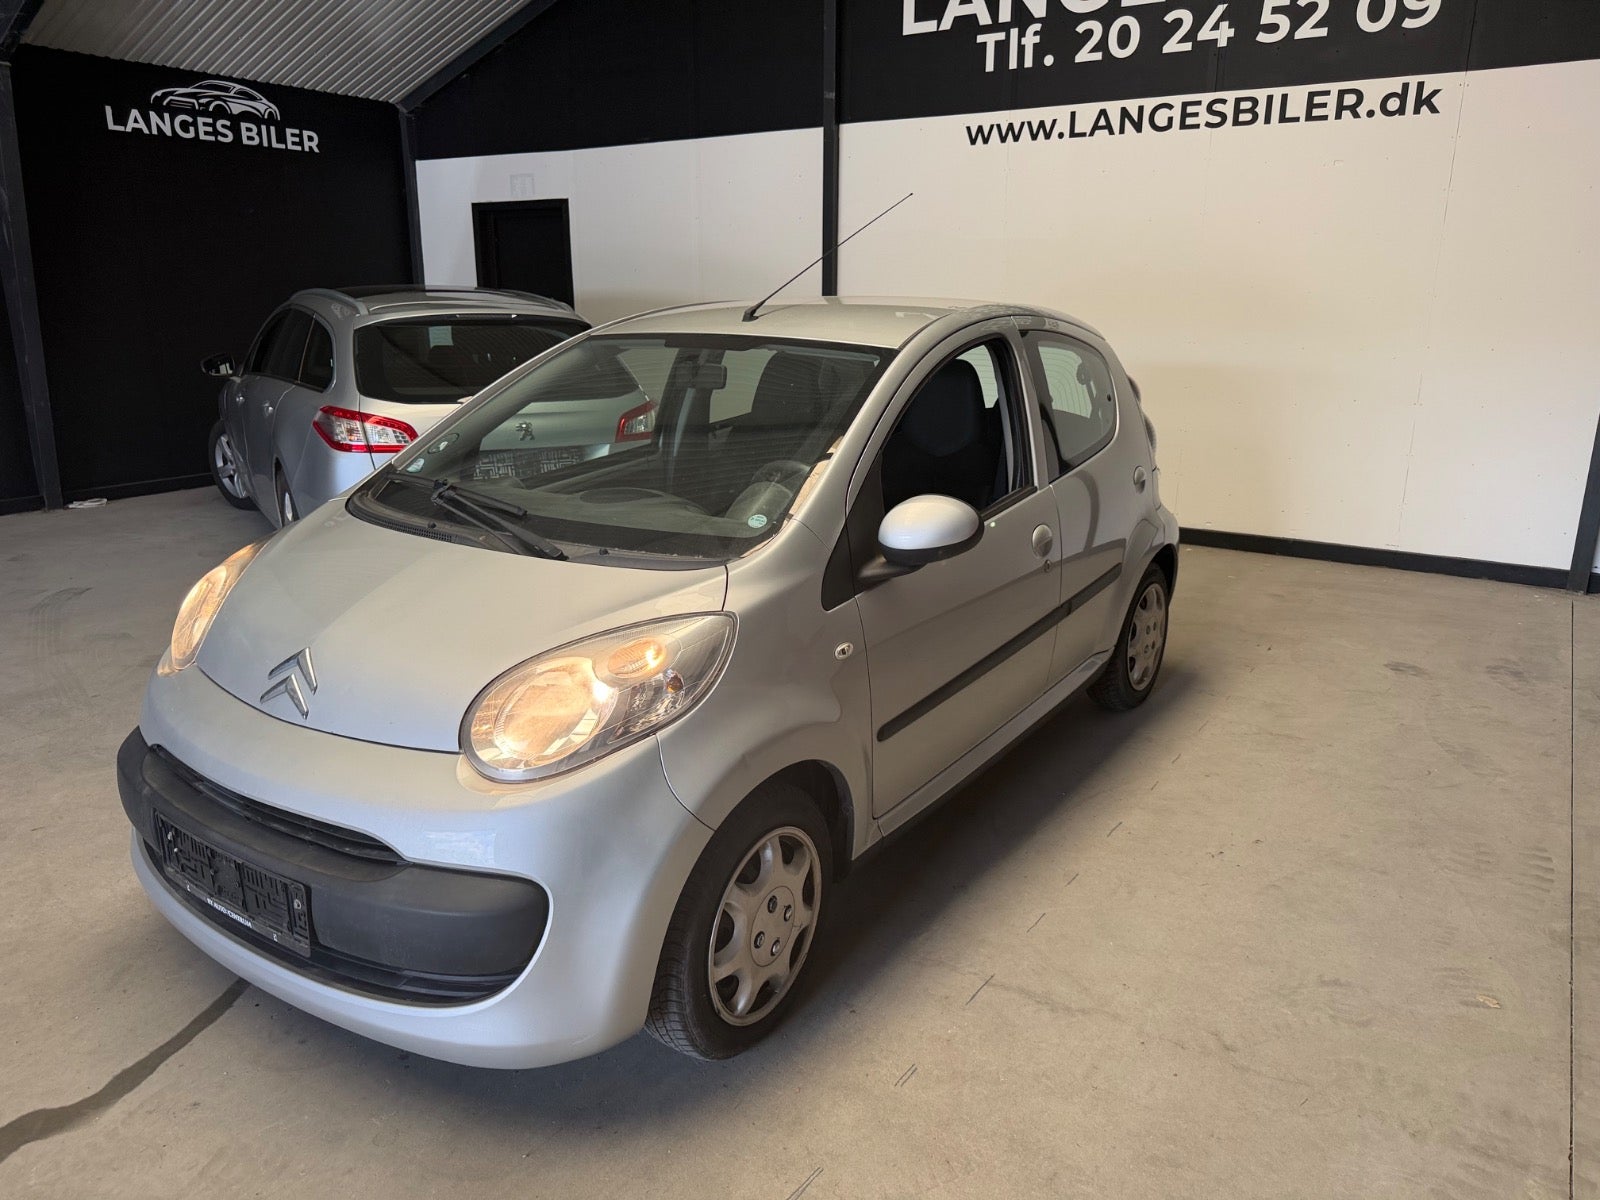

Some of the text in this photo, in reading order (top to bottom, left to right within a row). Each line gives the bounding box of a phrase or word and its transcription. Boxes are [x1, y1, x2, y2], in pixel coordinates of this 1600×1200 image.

[976, 23, 1055, 72] Tlf.
[1074, 15, 1141, 63] 20
[1162, 3, 1235, 54] 24
[1255, 0, 1329, 43] 52
[105, 105, 320, 153] LANGES BILER
[965, 81, 1443, 146] www.LANGESBILER.dk
